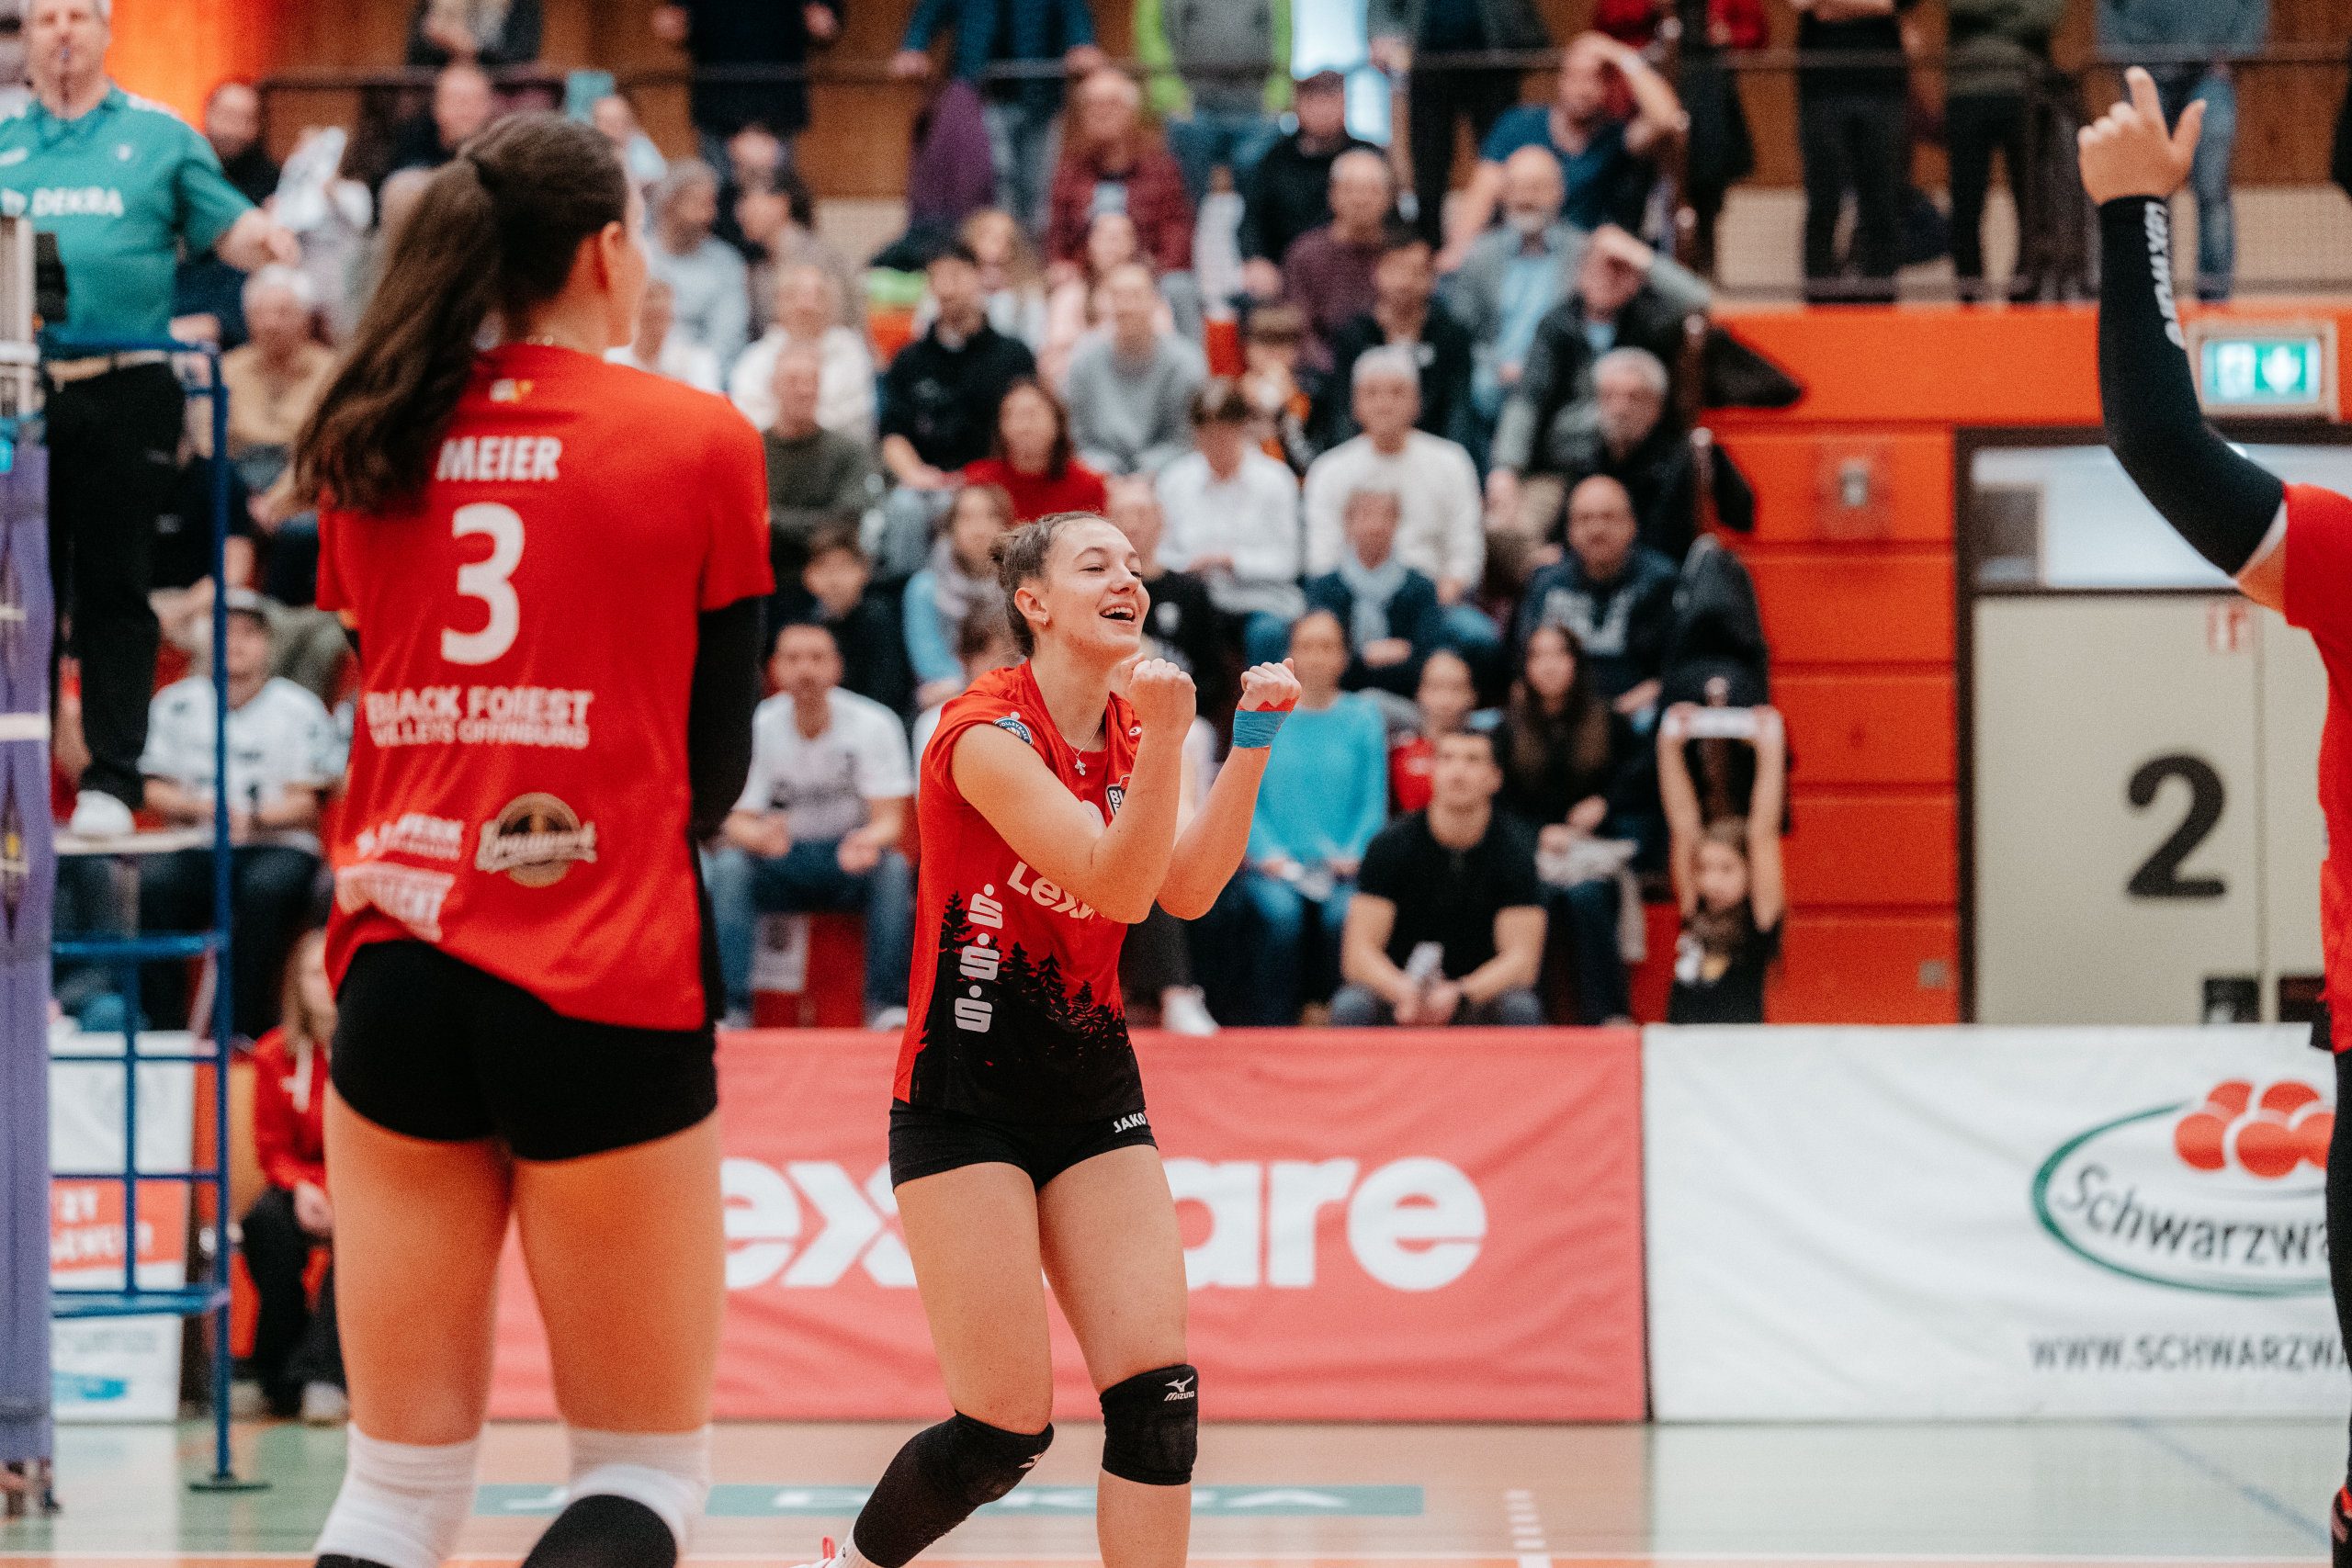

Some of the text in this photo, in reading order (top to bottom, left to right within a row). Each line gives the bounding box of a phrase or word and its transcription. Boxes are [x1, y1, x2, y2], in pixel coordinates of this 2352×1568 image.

[31, 186, 124, 217] DEKRA
[435, 435, 562, 481] MEIER
[441, 502, 525, 665] 3
[2126, 751, 2227, 899] 2
[1113, 1111, 1147, 1134] JAKO
[720, 1156, 1488, 1292] exare
